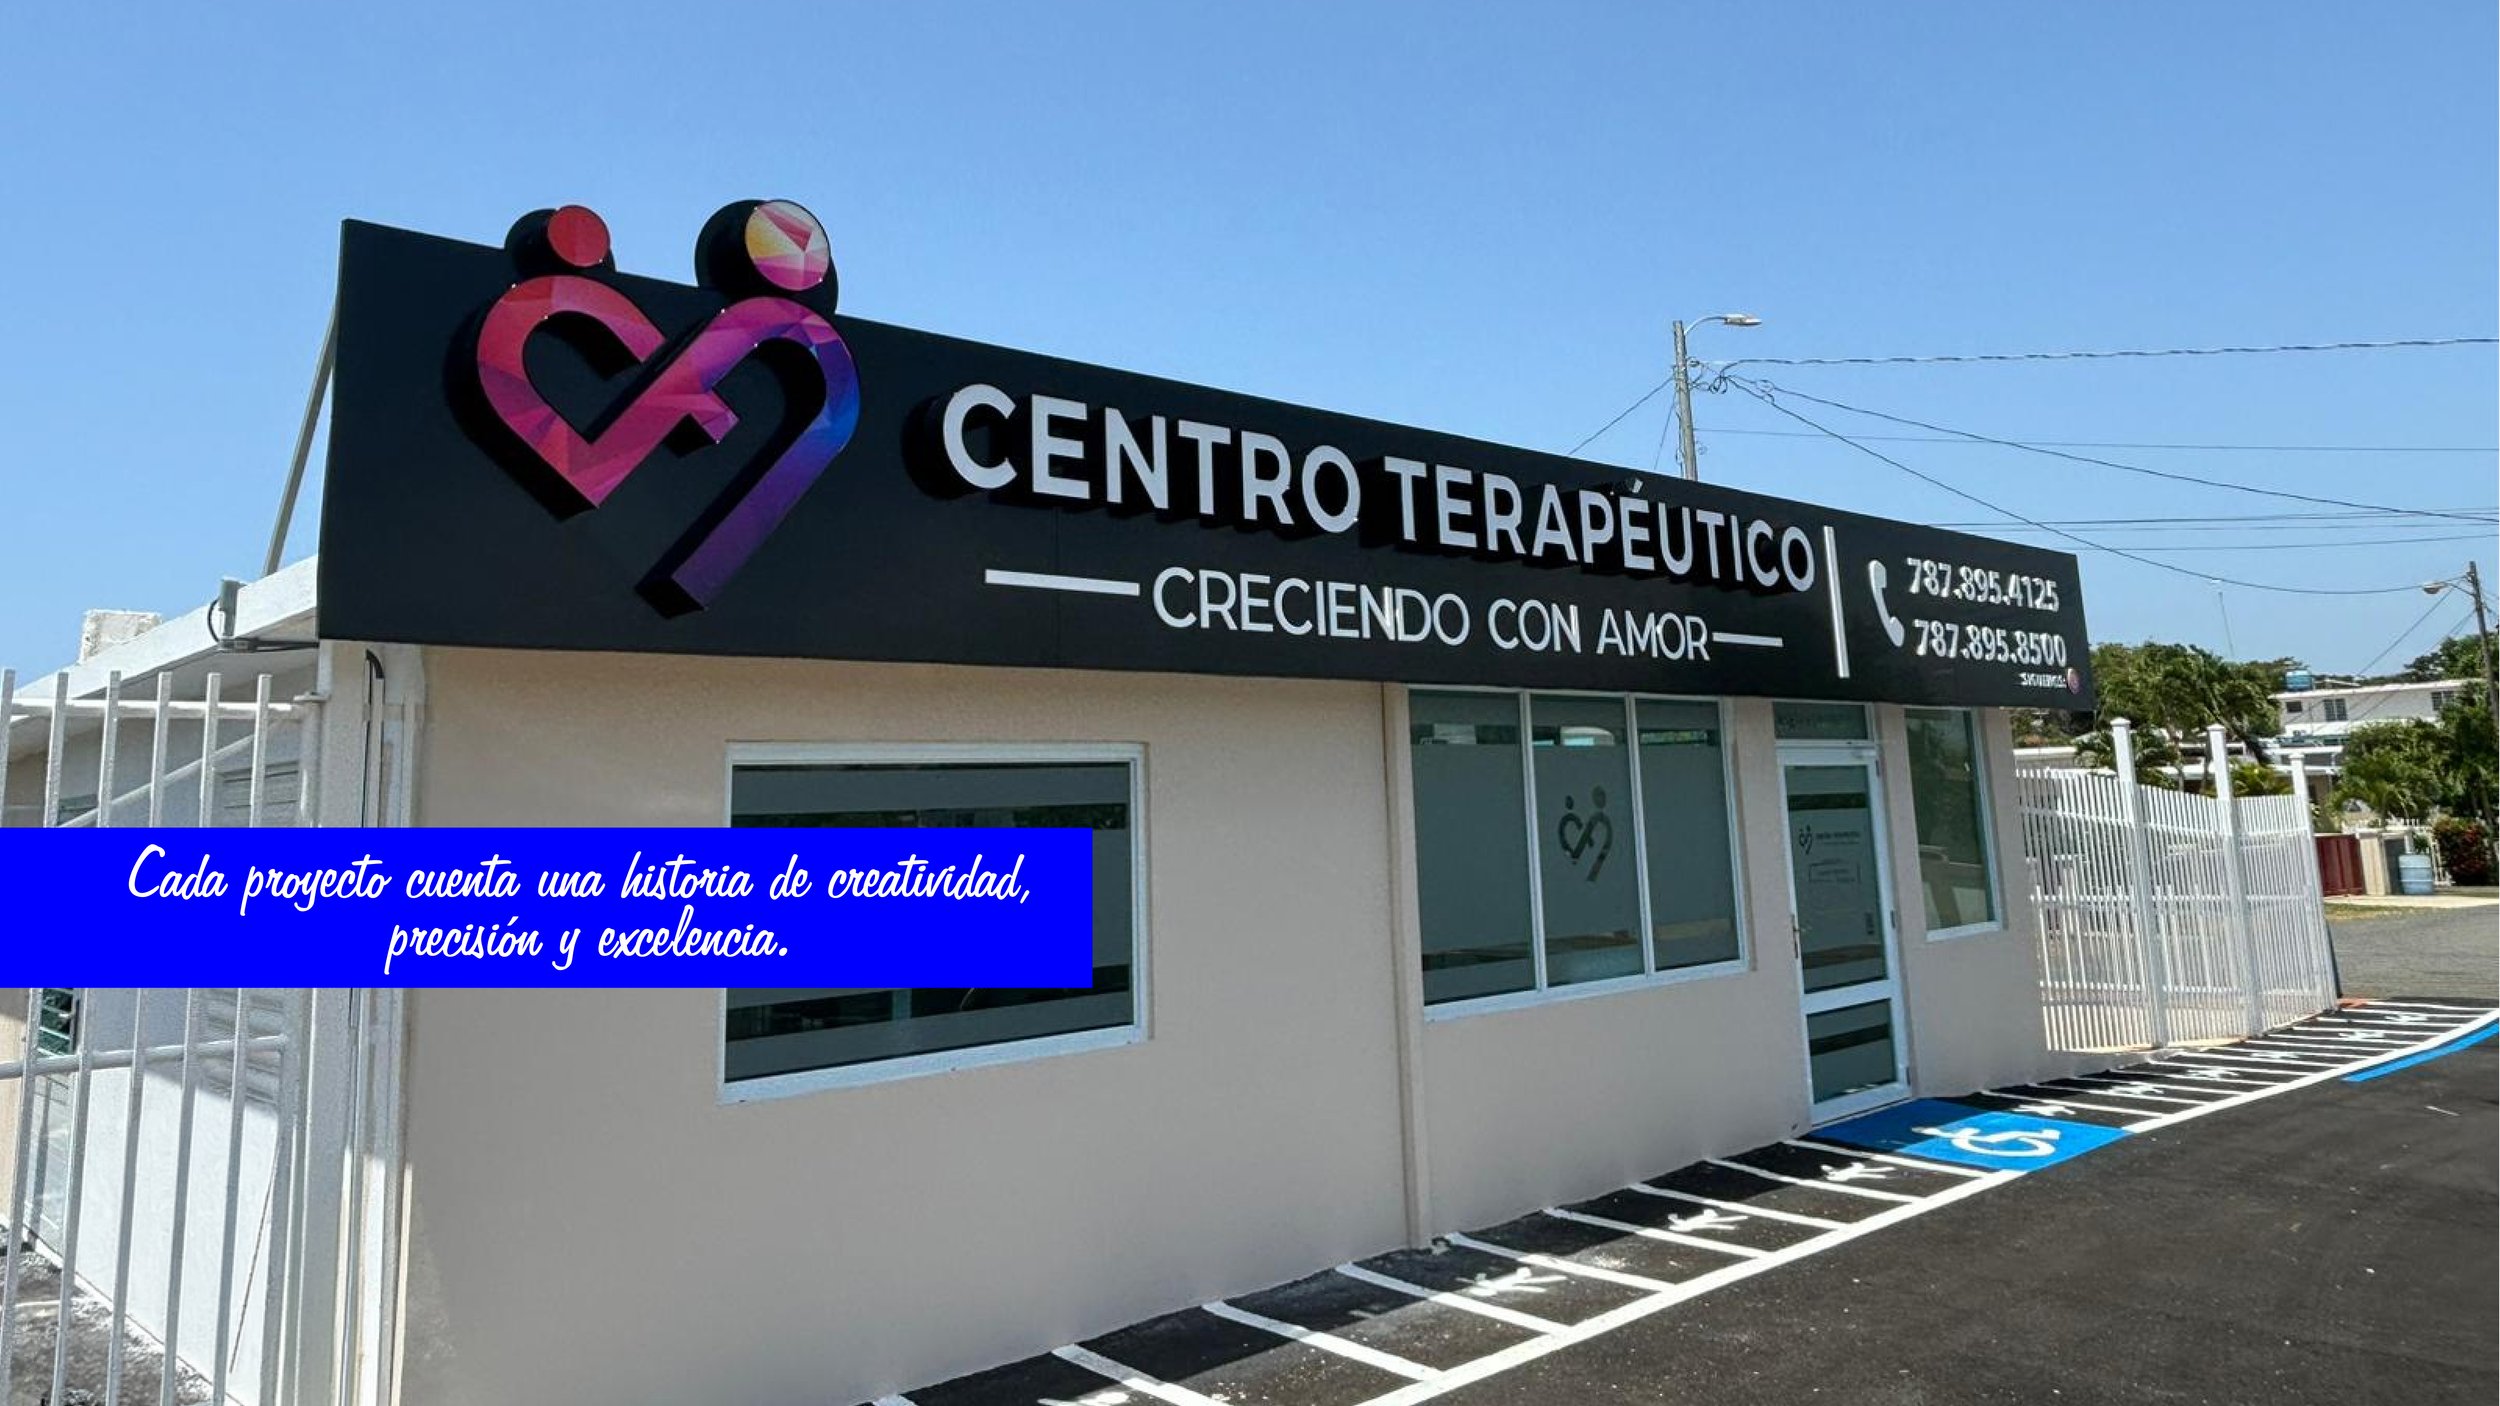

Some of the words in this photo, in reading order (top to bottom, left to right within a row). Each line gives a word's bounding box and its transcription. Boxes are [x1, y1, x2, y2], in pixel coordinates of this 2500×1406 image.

[943, 384, 1361, 533] CENTRO
[1384, 456, 1815, 592] TERAPÉUTICO
[1153, 566, 1470, 646] CRECIENDO
[1488, 598, 1582, 653] CON
[1596, 608, 1710, 661] AMOR
[1906, 557, 2060, 612] 787.895.4125
[1912, 618, 2068, 668] 787.895.8500
